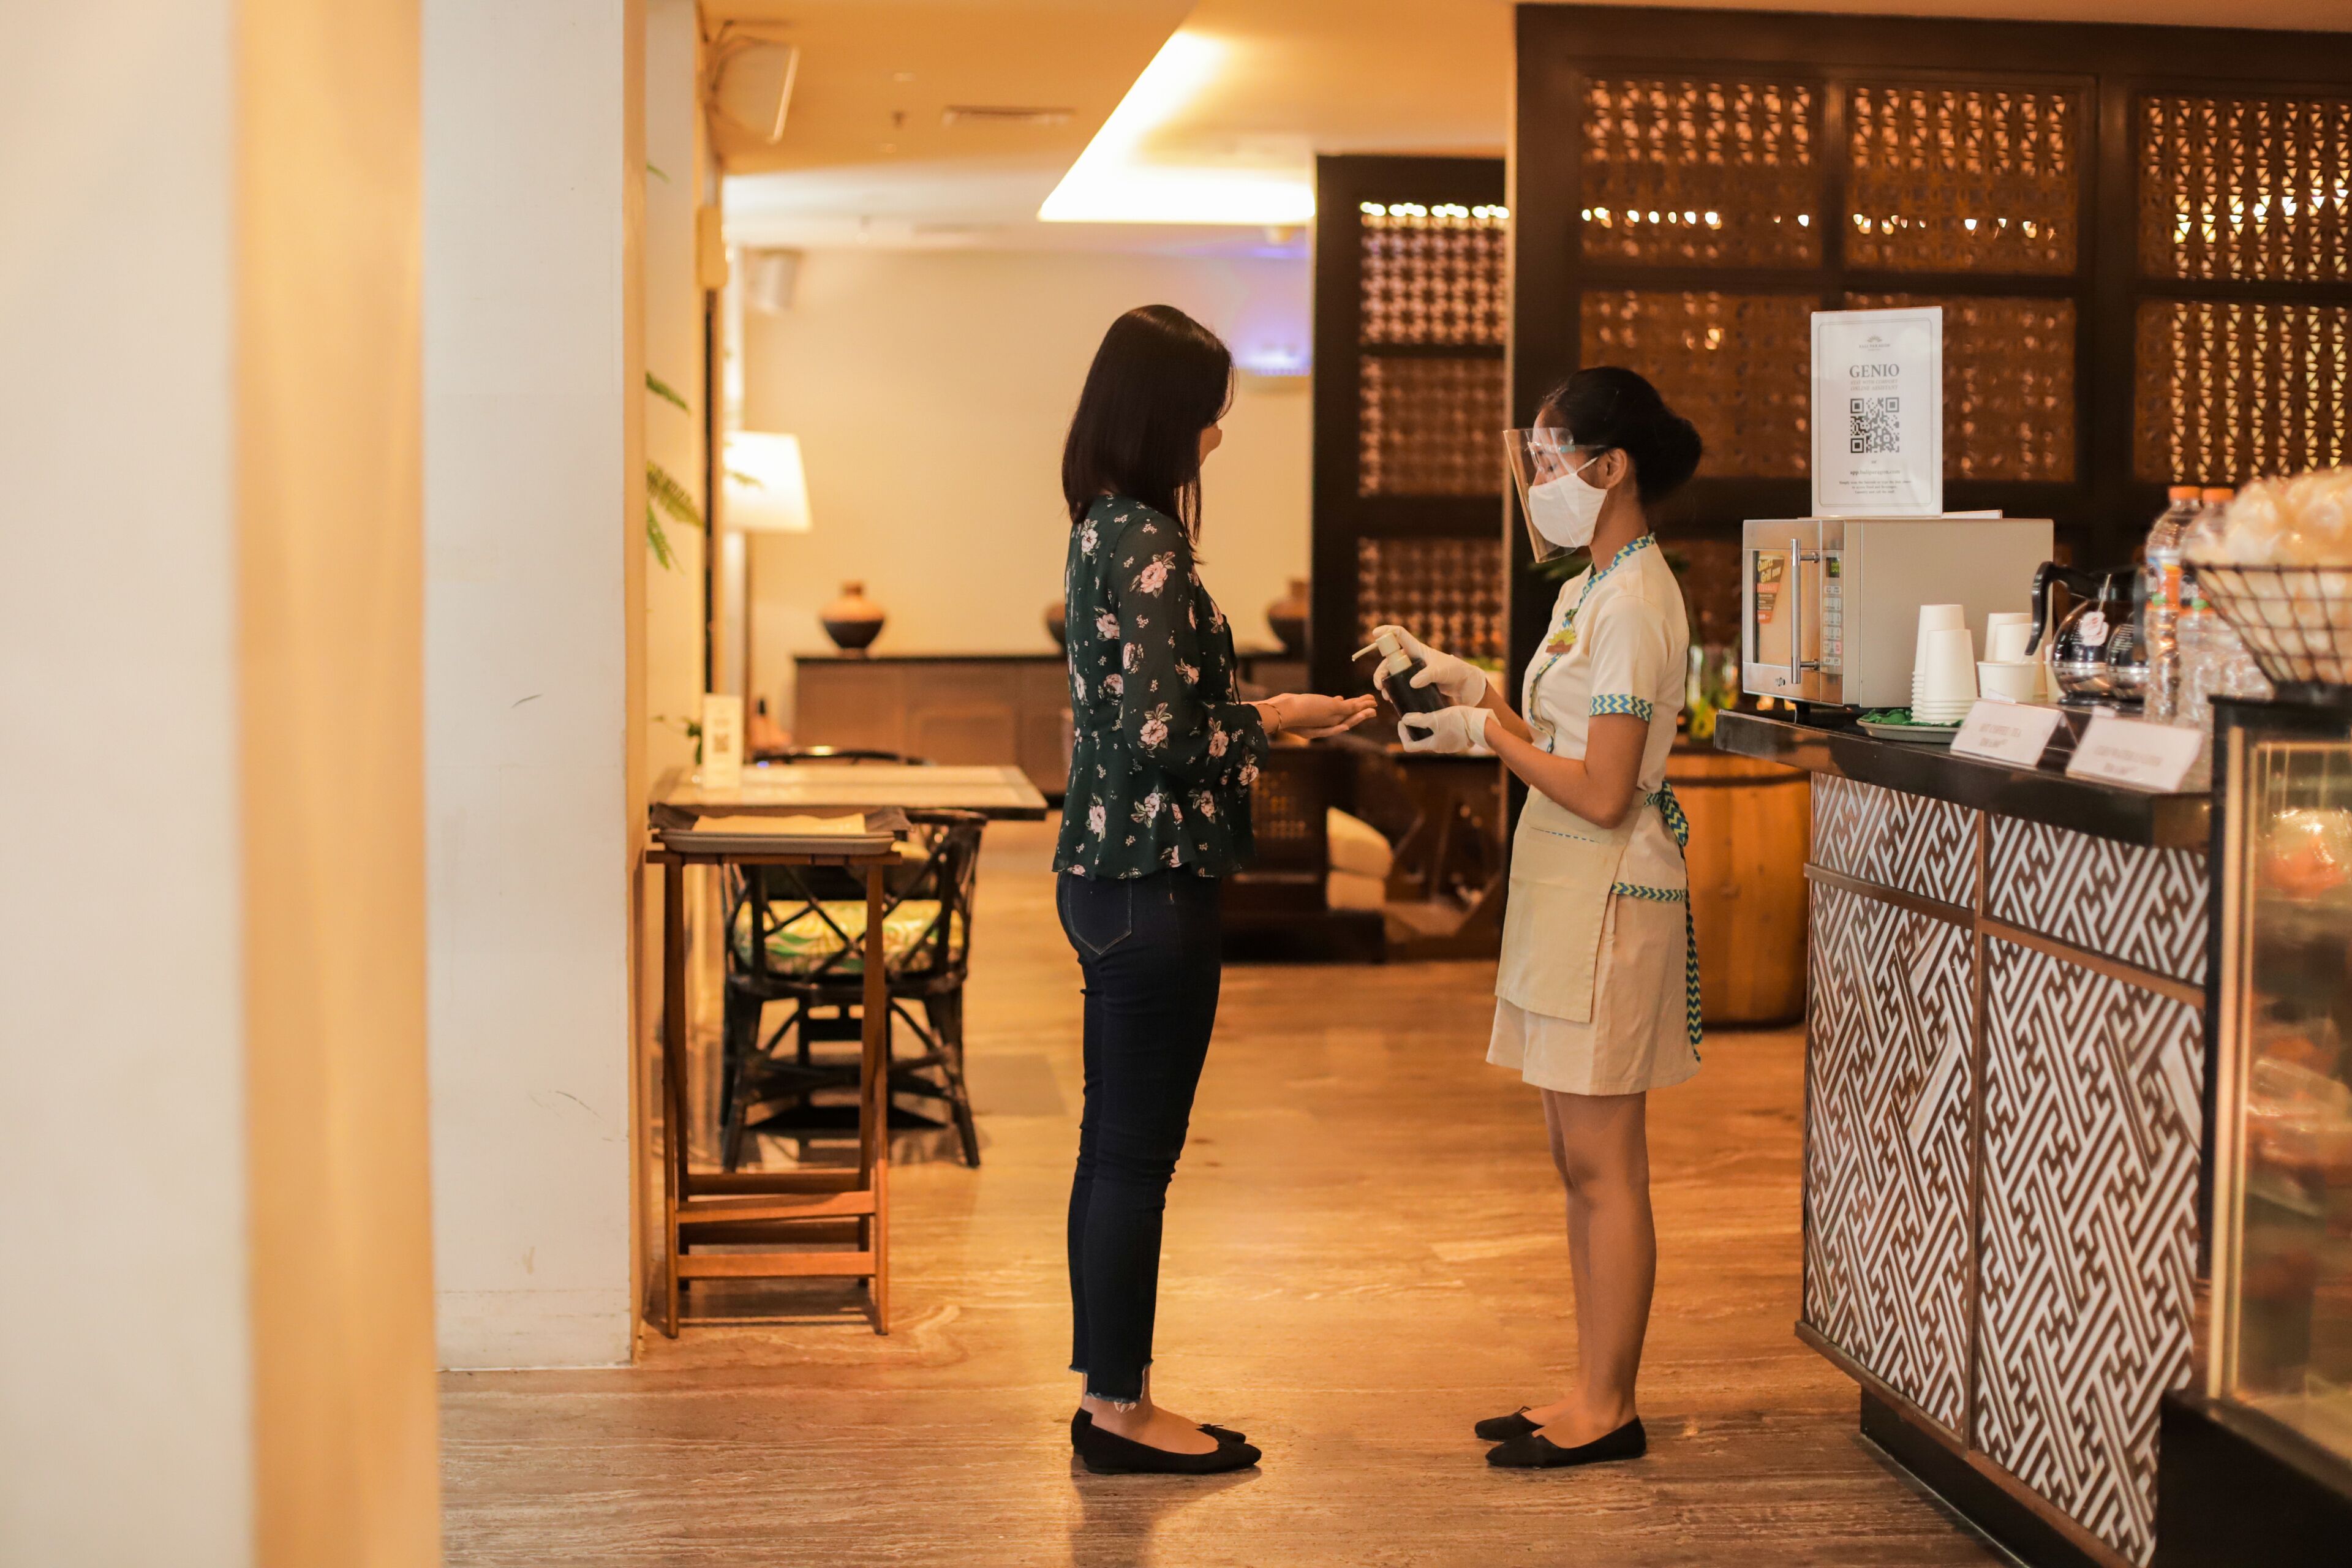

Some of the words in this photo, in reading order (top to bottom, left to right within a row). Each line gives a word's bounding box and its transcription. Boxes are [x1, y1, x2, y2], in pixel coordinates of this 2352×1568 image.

[1849, 364, 1900, 378] GENIO
[1757, 559, 1774, 571] Quartz
[1761, 568, 1771, 583] Grill
